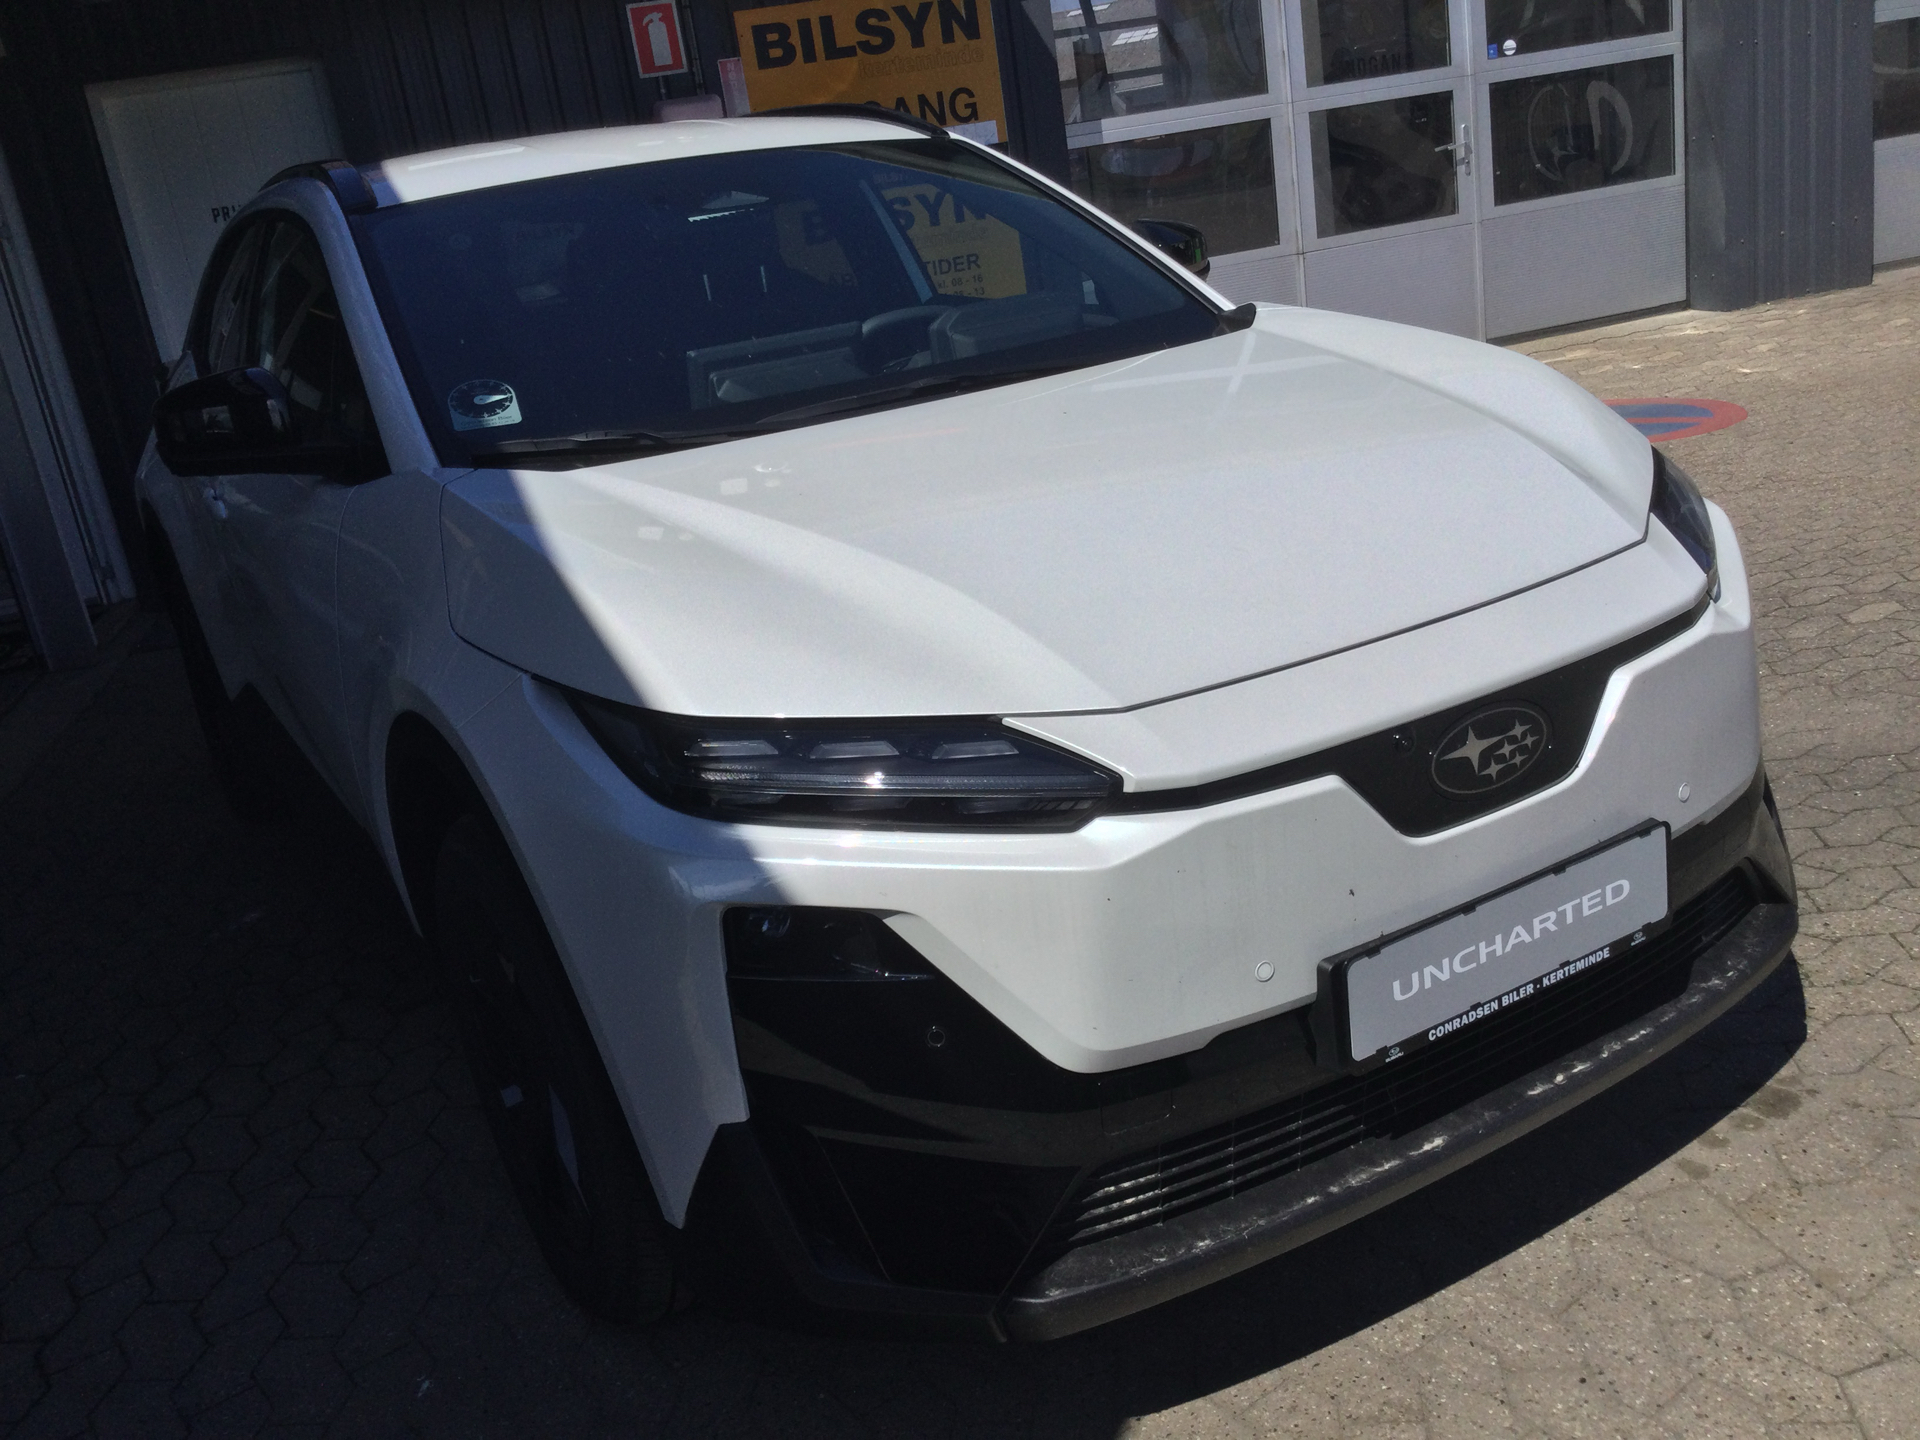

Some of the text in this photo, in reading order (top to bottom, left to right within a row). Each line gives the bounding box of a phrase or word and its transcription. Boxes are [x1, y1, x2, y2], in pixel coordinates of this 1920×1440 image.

[751, 0, 981, 70] BILSYN
[857, 45, 985, 79] kerteminde
[864, 87, 979, 126] ANG
[1392, 879, 1630, 1001] UNCHARTED
[1427, 999, 1499, 1042] CONRADSEN
[1501, 982, 1535, 1007] BILER
[1542, 946, 1611, 987] KERTEMINDE
